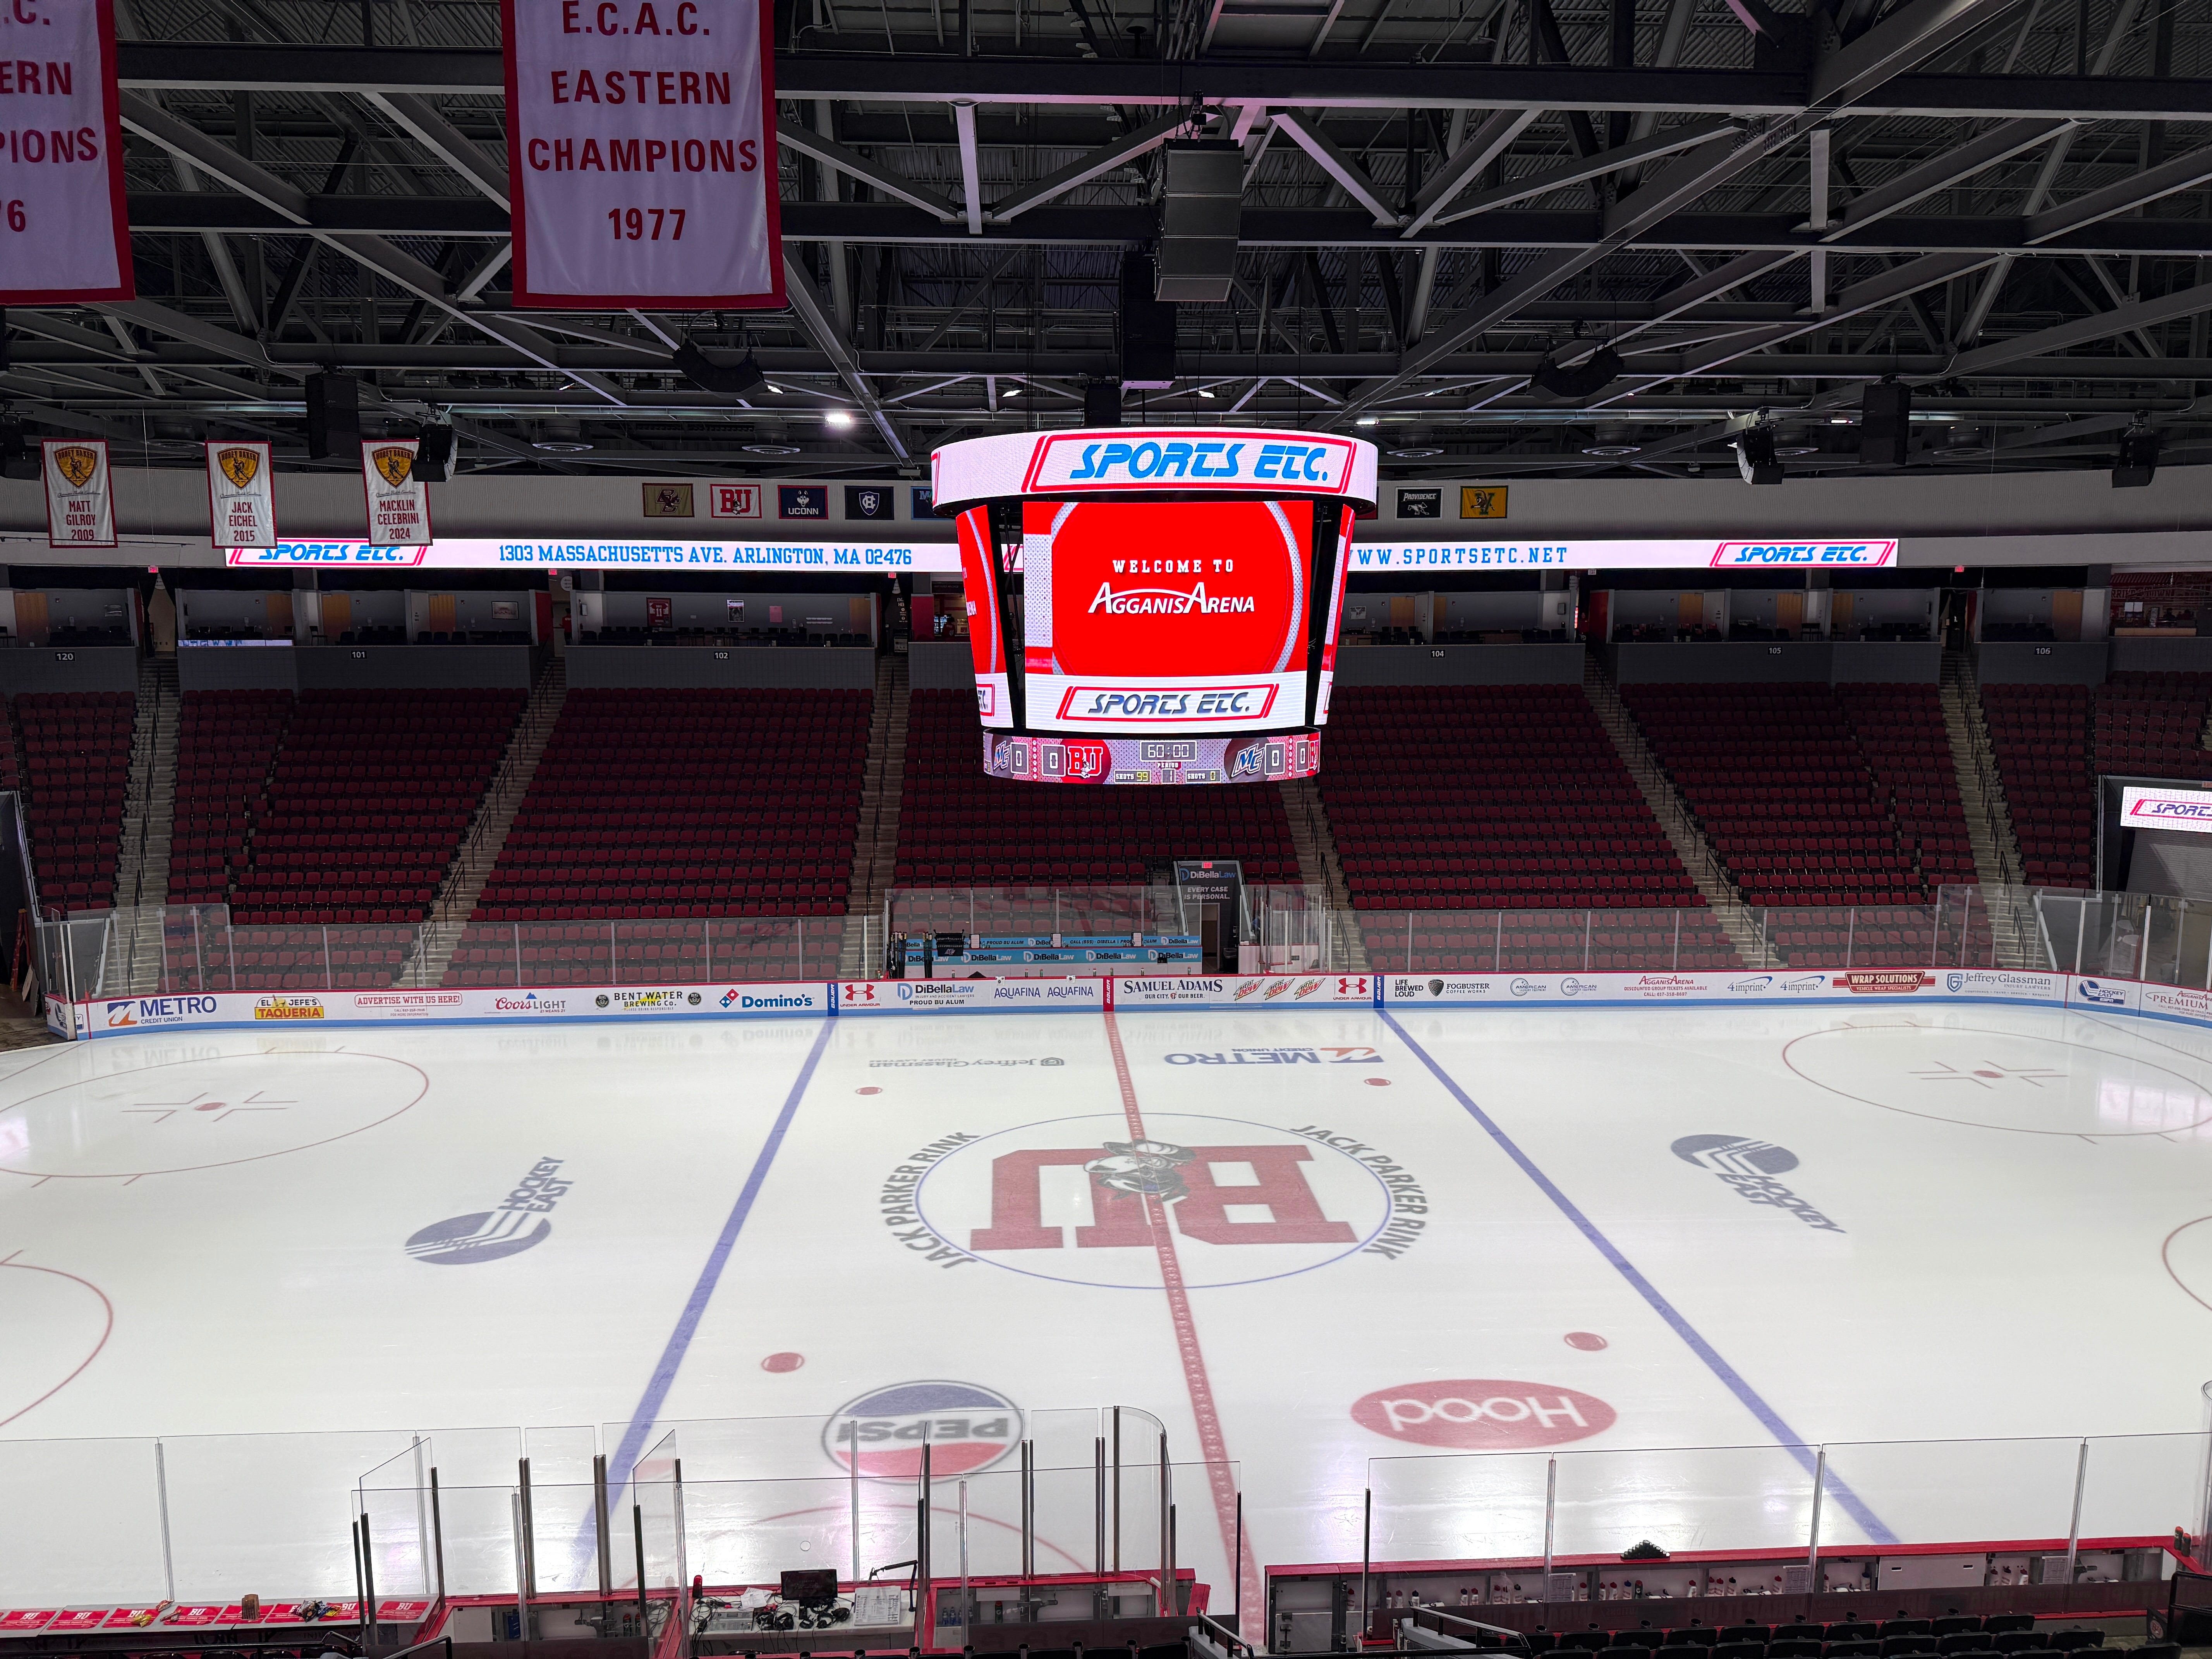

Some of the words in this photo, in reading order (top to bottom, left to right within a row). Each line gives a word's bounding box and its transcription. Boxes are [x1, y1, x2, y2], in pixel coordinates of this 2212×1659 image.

[563, 0, 709, 36] E.C.A.C.
[551, 70, 730, 104] EASTERN
[0, 127, 98, 163] IONS
[529, 138, 757, 172] CHAMPIONS
[608, 208, 685, 240] 1977
[77, 450, 94, 459] BAKER
[376, 450, 393, 459] HOBEY
[394, 450, 411, 459] BAKER
[1070, 442, 1245, 479] SPORTS
[1254, 445, 1328, 481] ETC.
[720, 489, 752, 513] BU
[1403, 493, 1436, 501] PROVIDENCE
[69, 501, 90, 512] MATT
[232, 502, 253, 513] JACK
[380, 500, 415, 512] MACKLIN
[66, 514, 95, 526] GILROY
[229, 515, 257, 526] EICHEL
[378, 513, 419, 525] CELEBRINI
[71, 529, 94, 540] 2009
[234, 531, 255, 541] 2015
[390, 528, 410, 539] 2024
[356, 545, 404, 560] ETC.
[499, 545, 533, 561] 1303
[538, 546, 684, 563] MASSACHUSETTS
[689, 547, 727, 563] AVE.
[734, 548, 828, 565] ARLINGTON,
[834, 549, 860, 565] MA
[866, 549, 912, 565] 02476
[1348, 547, 1568, 565] WW.SPORTSETC.NET
[1735, 546, 1817, 562] SPORTS
[1820, 546, 1868, 562] ETC.
[1113, 559, 1202, 573] WELCOME
[1215, 559, 1234, 572] TO
[1087, 694, 1188, 715] SPORTS
[1196, 692, 1250, 713] ETC.
[1148, 744, 1189, 758] 60:00
[1068, 747, 1104, 776] BU
[1136, 772, 1148, 781] 99
[2152, 804, 2212, 817] SPORT
[1124, 980, 1175, 994] SAMUEL
[1176, 979, 1223, 993] ADAMS
[1851, 975, 1874, 984] WRAP
[1875, 974, 1918, 984] SOLUTIONS
[1964, 973, 1997, 984] Jeffrey
[1998, 974, 2051, 985] Glassman
[614, 992, 641, 1001] BENT
[645, 991, 683, 1000] WATER
[915, 984, 975, 994] DiBellaLaw
[994, 988, 1041, 999] AQUAFINA
[1047, 986, 1094, 998] AQUAFINA
[140, 996, 217, 1017] METRO
[495, 998, 532, 1010] Coors
[534, 1000, 566, 1010] LIGHT
[742, 994, 813, 1008] Domino's
[2153, 994, 2209, 1010] PREMIUM
[258, 1008, 321, 1018] TAQUERIA
[1164, 1052, 1321, 1066] METRO
[908, 1132, 981, 1162] RINK
[1290, 1125, 1376, 1155] JACK
[497, 1156, 564, 1211] HOCKEY
[1359, 1155, 1428, 1214] PARKER
[1714, 1173, 1785, 1207] EAST
[525, 1177, 574, 1212] EAST
[881, 1165, 928, 1226] PARKER
[970, 1145, 1359, 1250] BU
[1744, 1175, 1847, 1234] HOCKEY
[1361, 1217, 1425, 1260] RINK
[893, 1226, 978, 1269] JACK
[1382, 1396, 1588, 1432] Hood
[836, 1418, 1008, 1443] PEPSI
[342, 1603, 356, 1611] BU
[397, 1602, 413, 1611] BU
